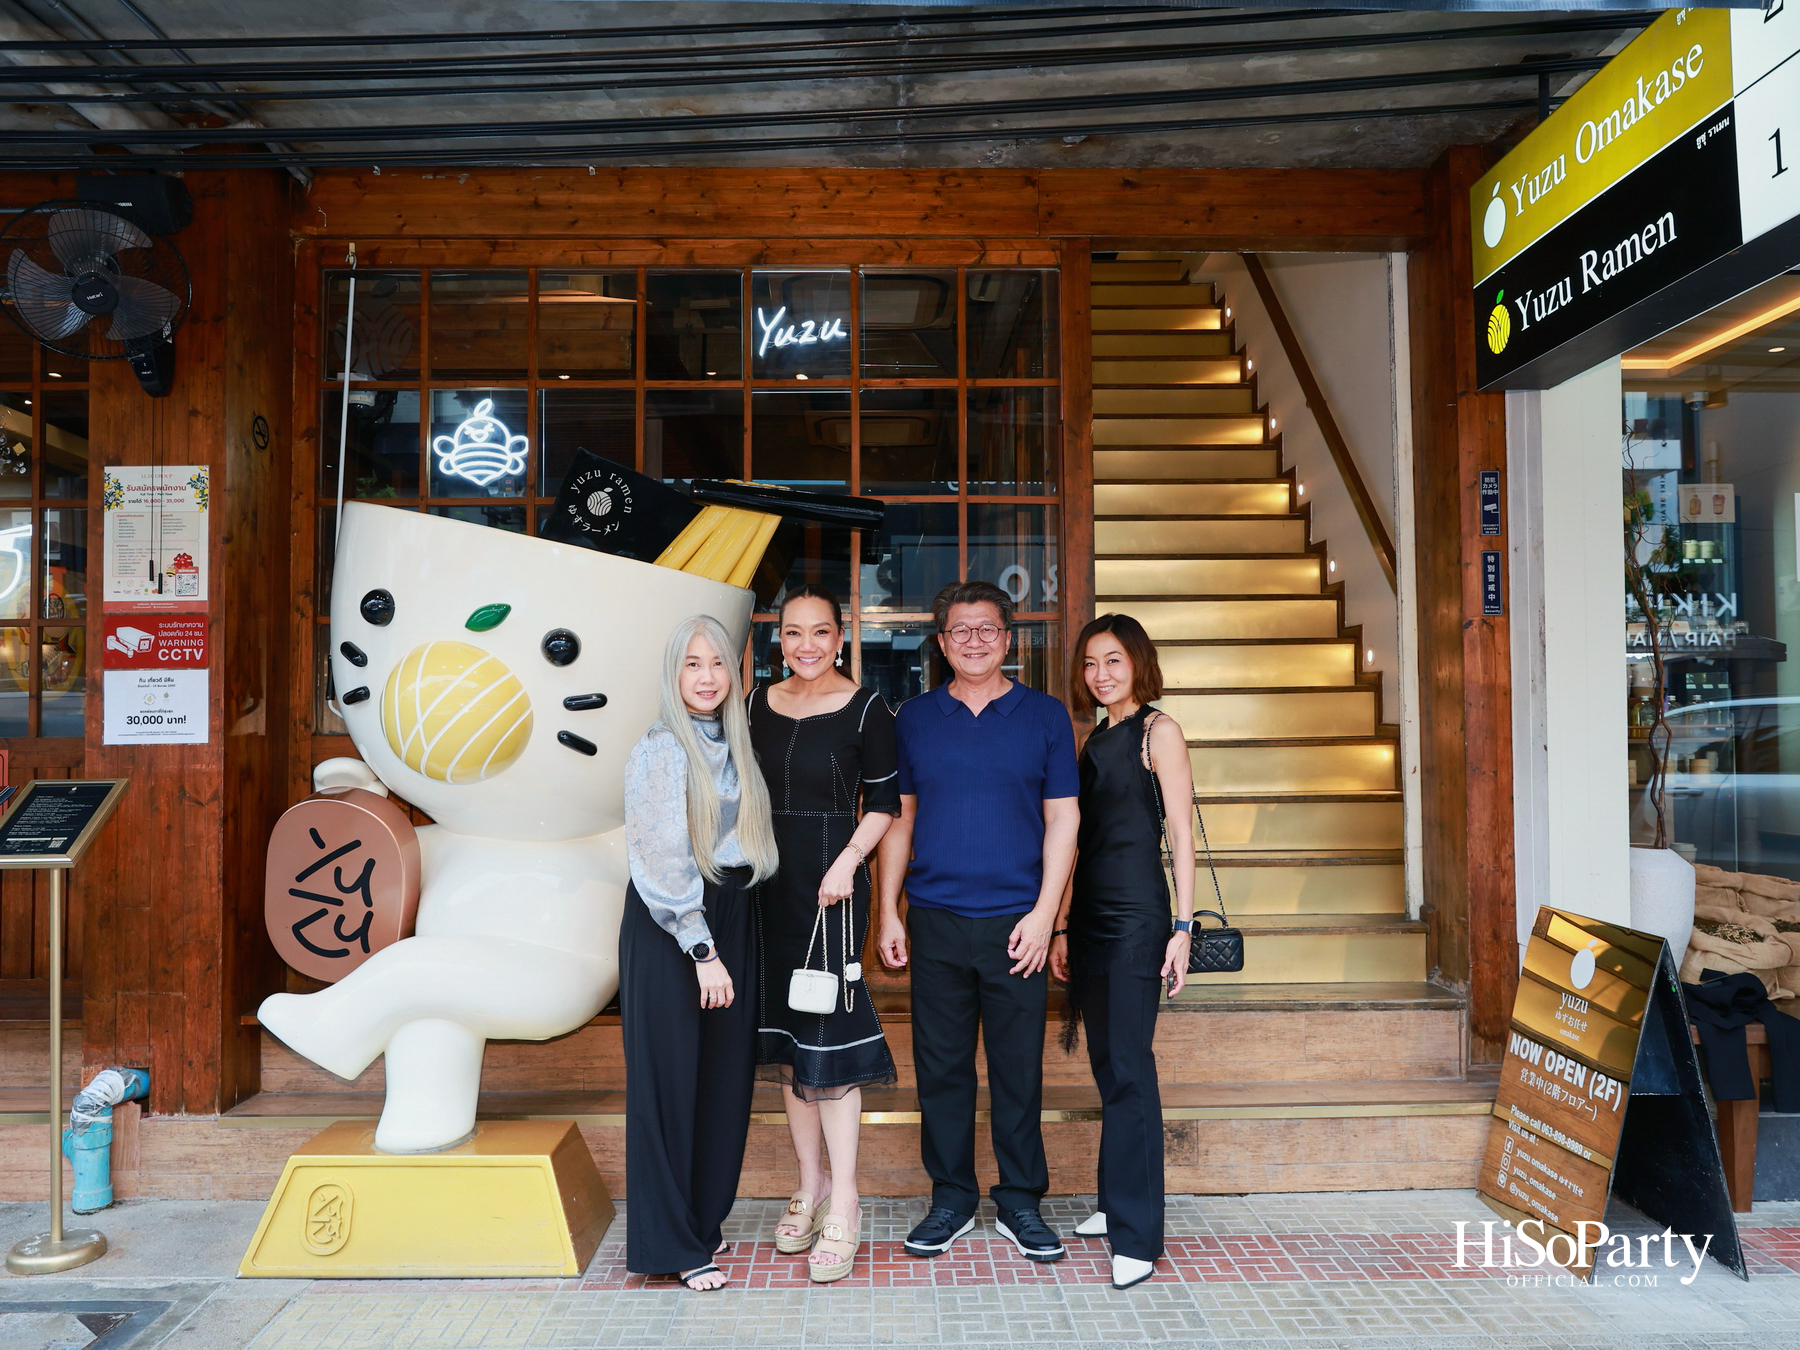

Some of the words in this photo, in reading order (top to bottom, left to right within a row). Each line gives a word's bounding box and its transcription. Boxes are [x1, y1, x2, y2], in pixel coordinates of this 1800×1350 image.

[1511, 153, 1567, 217] Yuzu
[1574, 43, 1704, 164] Omakase
[1708, 116, 1730, 138] ราเมน
[1768, 127, 1788, 179] 1
[1514, 276, 1574, 332] Yuzu
[1579, 211, 1678, 294] Ramen
[758, 306, 847, 357] Yuzu
[570, 469, 602, 494] yuzu
[609, 472, 633, 514] ramen
[158, 648, 204, 661] CCTV
[126, 716, 163, 726] 30,000
[167, 715, 186, 724] บาท!
[1558, 992, 1588, 1014] yuzu
[1555, 1011, 1588, 1032] ゆずお任せ
[1560, 1029, 1580, 1041] omakase
[1510, 1033, 1543, 1066] NOW
[1544, 1050, 1587, 1088] OPEN
[1589, 1071, 1622, 1112] (2F)
[1508, 1118, 1521, 1134] Visit
[1521, 1130, 1529, 1139] us
[1529, 1134, 1536, 1144] at
[1511, 1104, 1530, 1124] Please
[1530, 1118, 1542, 1130] call
[1584, 1150, 1592, 1160] or
[1516, 1148, 1531, 1162] yuzu
[1531, 1158, 1558, 1180] omakase
[1512, 1166, 1557, 1200] yuzu_omakase
[1509, 1182, 1559, 1223] @yuzu_omakase
